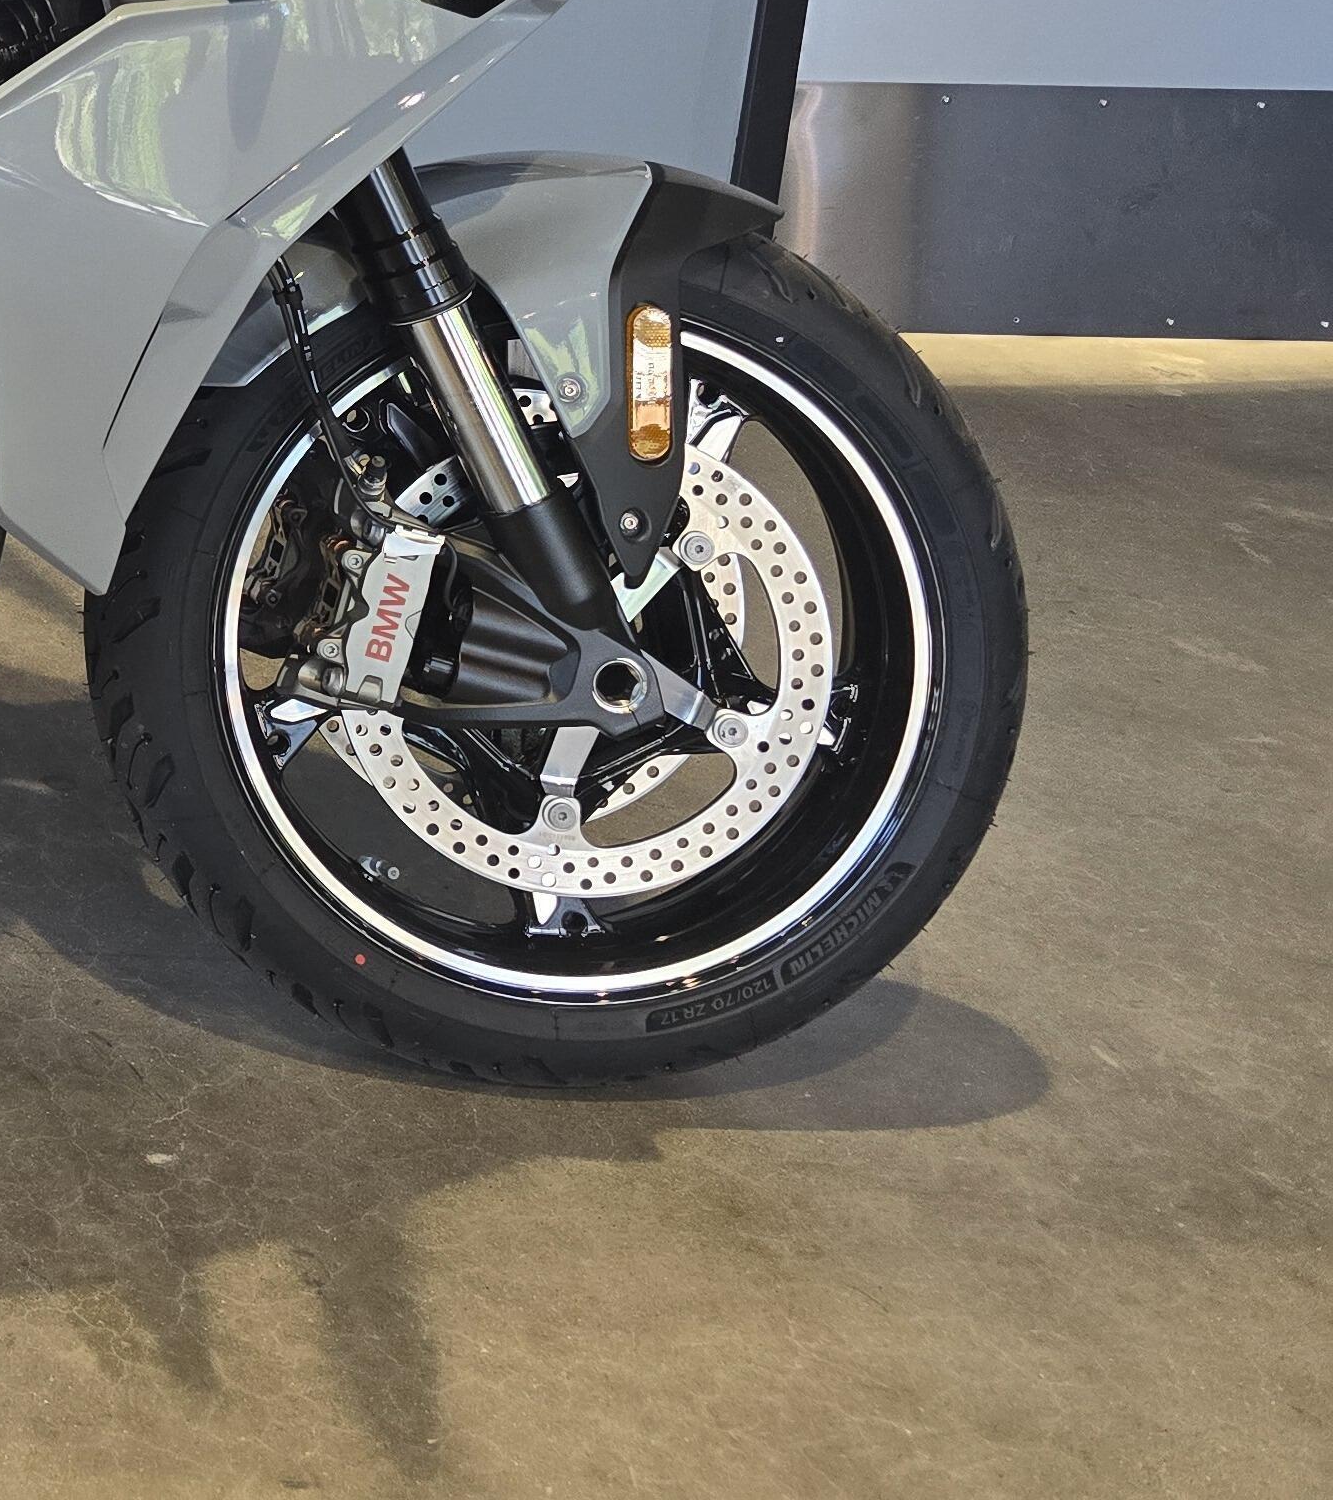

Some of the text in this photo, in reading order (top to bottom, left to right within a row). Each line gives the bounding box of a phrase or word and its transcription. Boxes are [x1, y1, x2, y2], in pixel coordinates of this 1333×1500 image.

[365, 573, 410, 662] BMW
[660, 893, 882, 1027] MICHELIN 120/70 ZR 17
